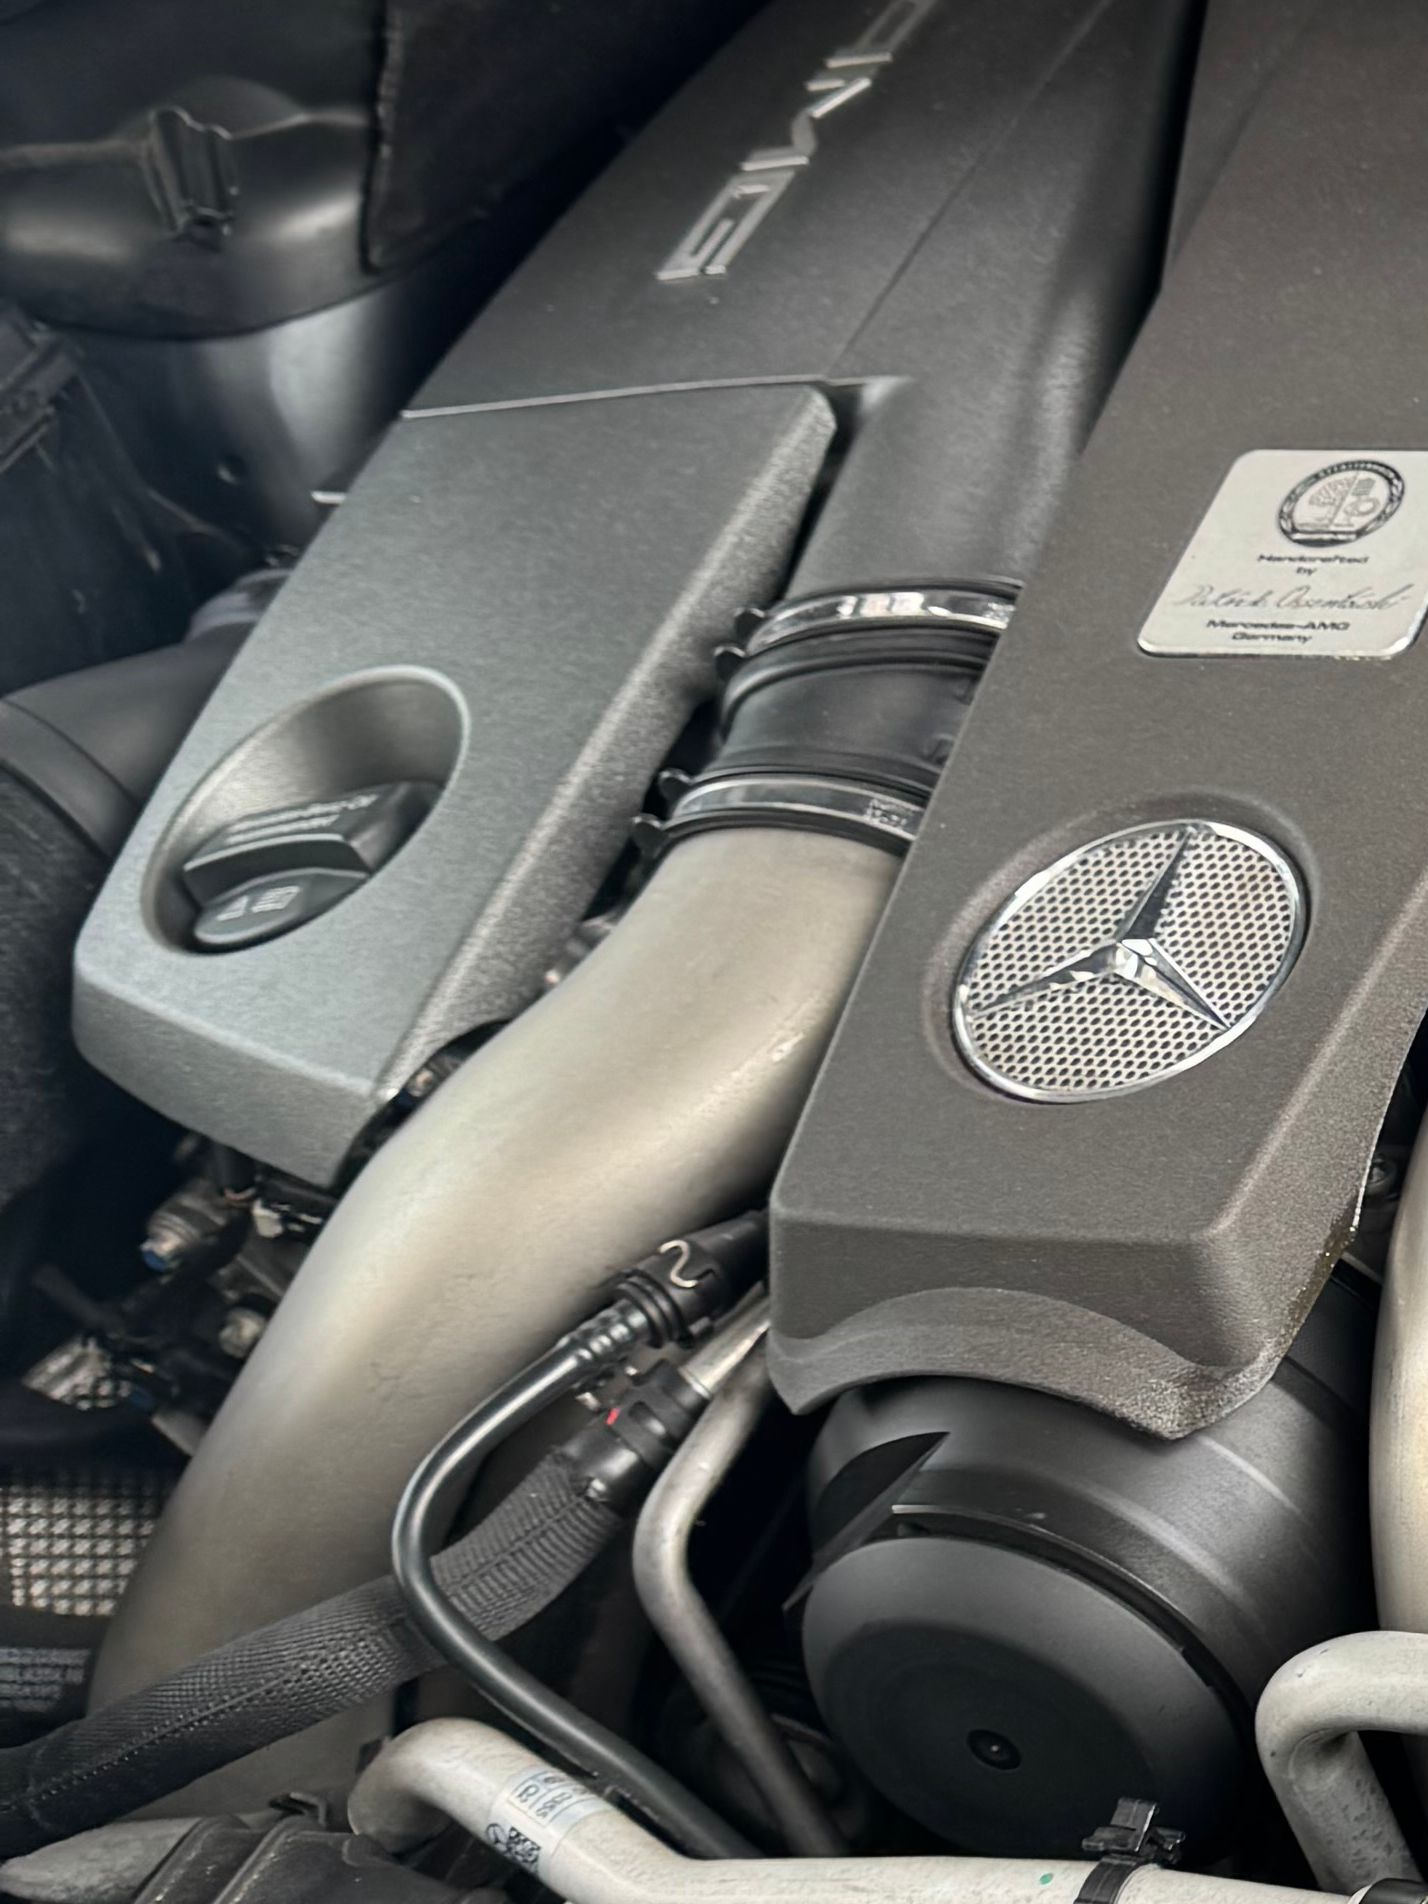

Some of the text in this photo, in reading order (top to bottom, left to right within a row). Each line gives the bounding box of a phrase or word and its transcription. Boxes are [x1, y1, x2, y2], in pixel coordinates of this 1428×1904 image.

[1257, 553, 1369, 564] Handcrafted
[1296, 565, 1318, 577] by
[1206, 619, 1351, 631] Mercedes-AMG
[1231, 631, 1313, 644] Germany
